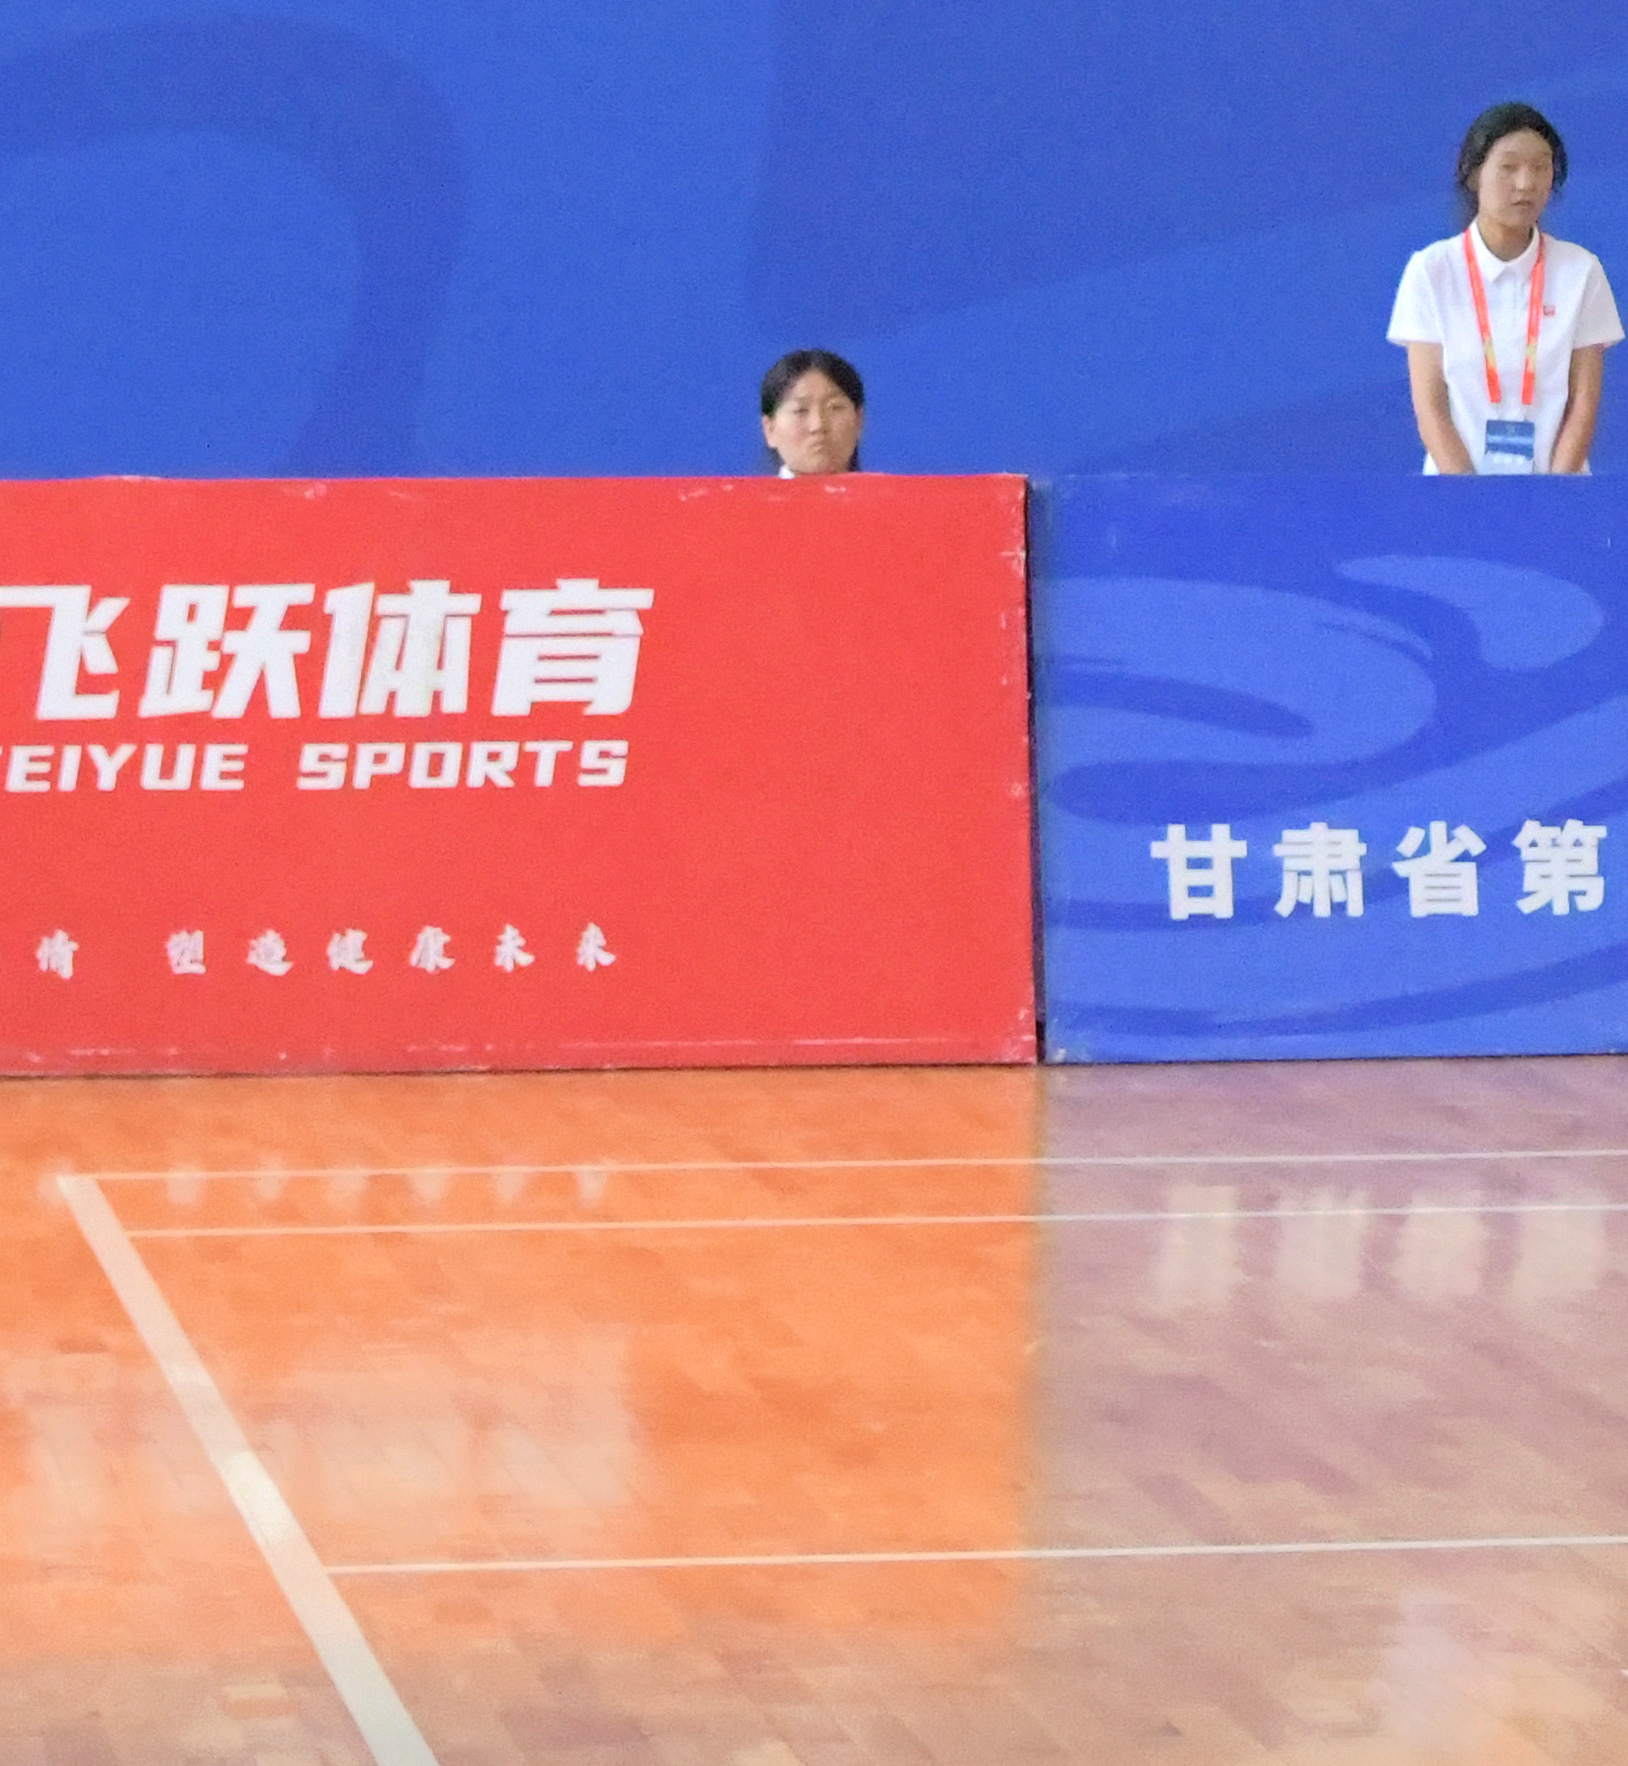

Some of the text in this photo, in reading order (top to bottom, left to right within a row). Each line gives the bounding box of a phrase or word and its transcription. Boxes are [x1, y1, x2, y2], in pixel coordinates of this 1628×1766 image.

[0, 578, 655, 721] 飞跃体育
[0, 739, 629, 793] EIYUE SPORTS
